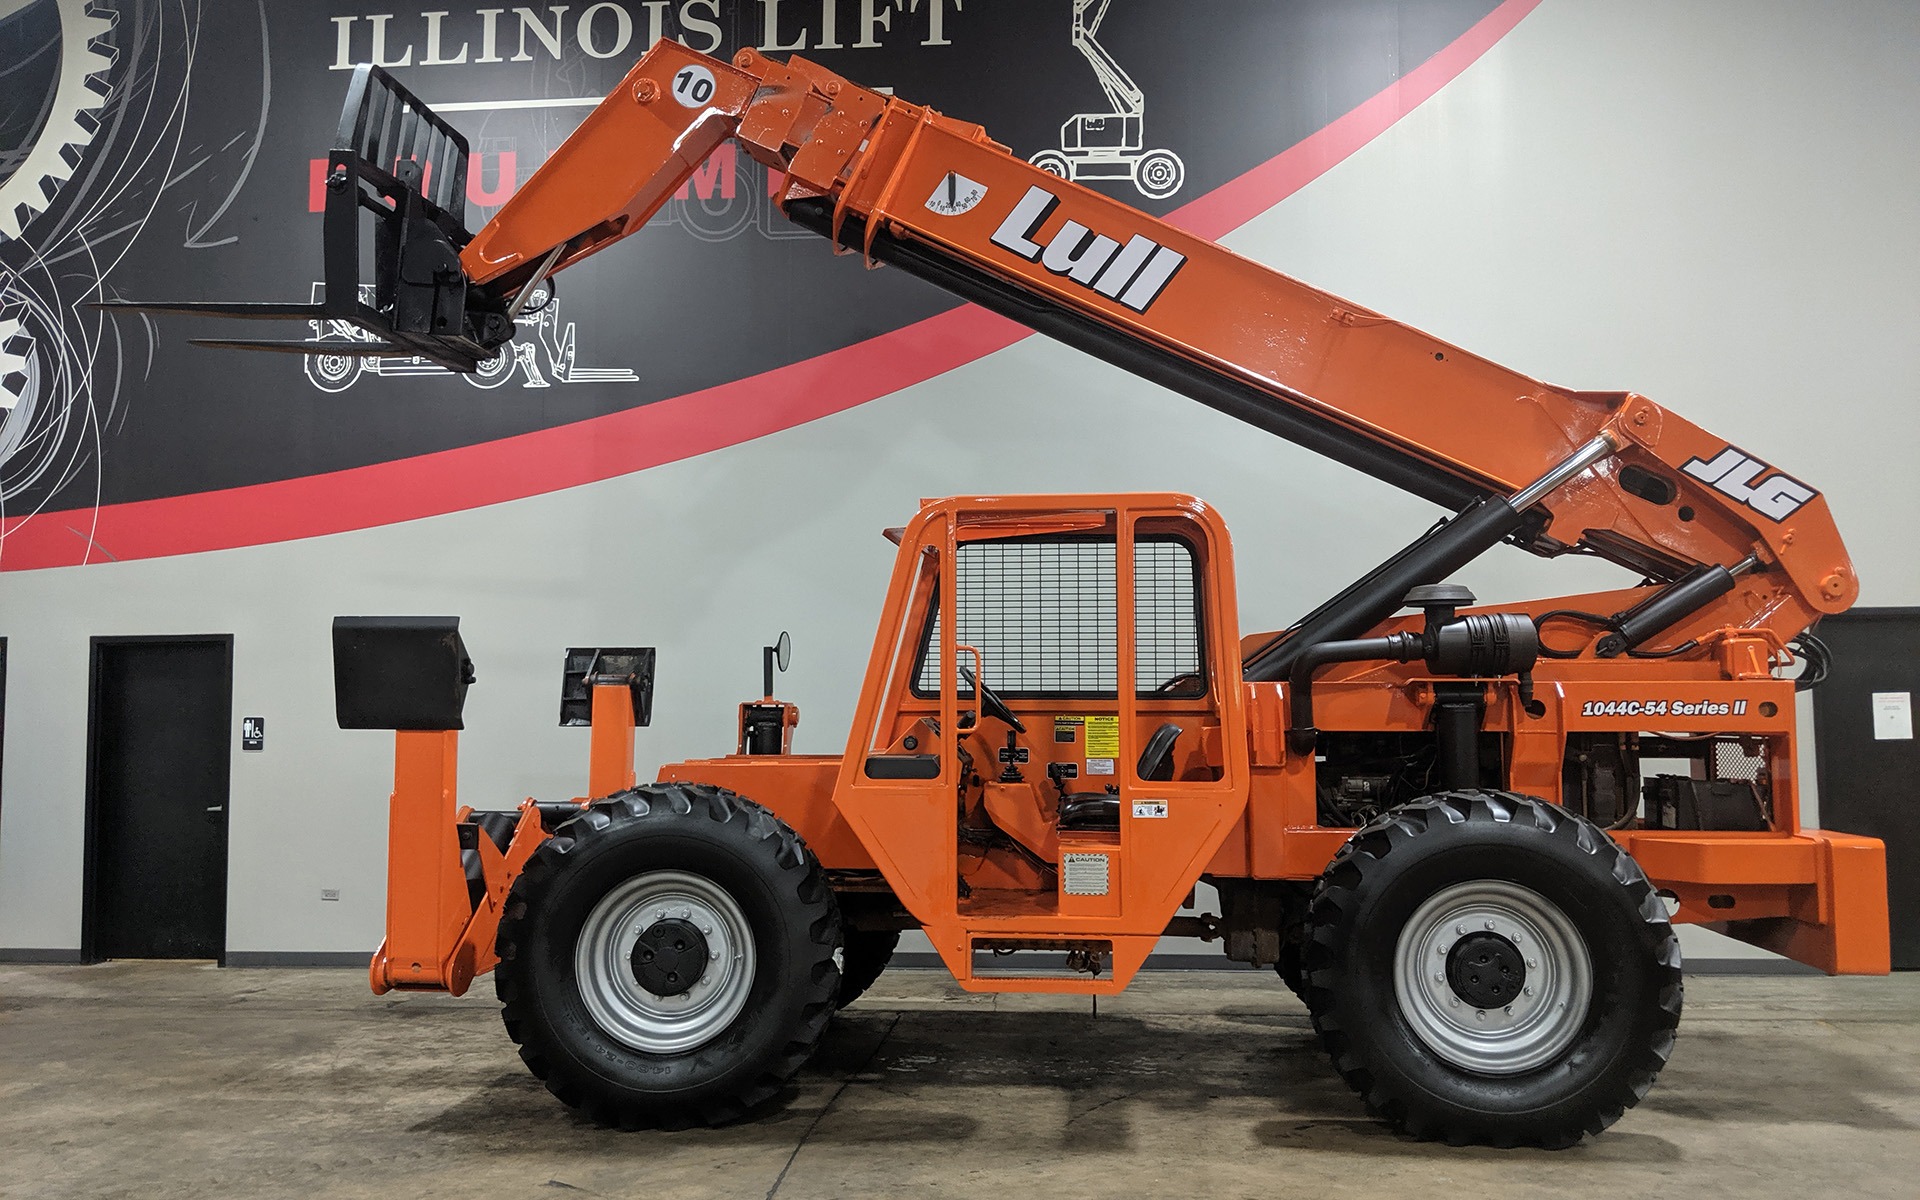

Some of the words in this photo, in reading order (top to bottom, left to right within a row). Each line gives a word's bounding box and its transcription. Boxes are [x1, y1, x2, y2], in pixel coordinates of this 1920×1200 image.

[329, 0, 723, 71] ILLINOIS
[757, 0, 962, 51] LIFT
[677, 70, 713, 103] 10
[990, 184, 1188, 315] Lull
[1678, 445, 1818, 523] JLG
[1582, 700, 1667, 716] 1044C-54
[1671, 700, 1730, 716] Series
[1733, 700, 1748, 715] II
